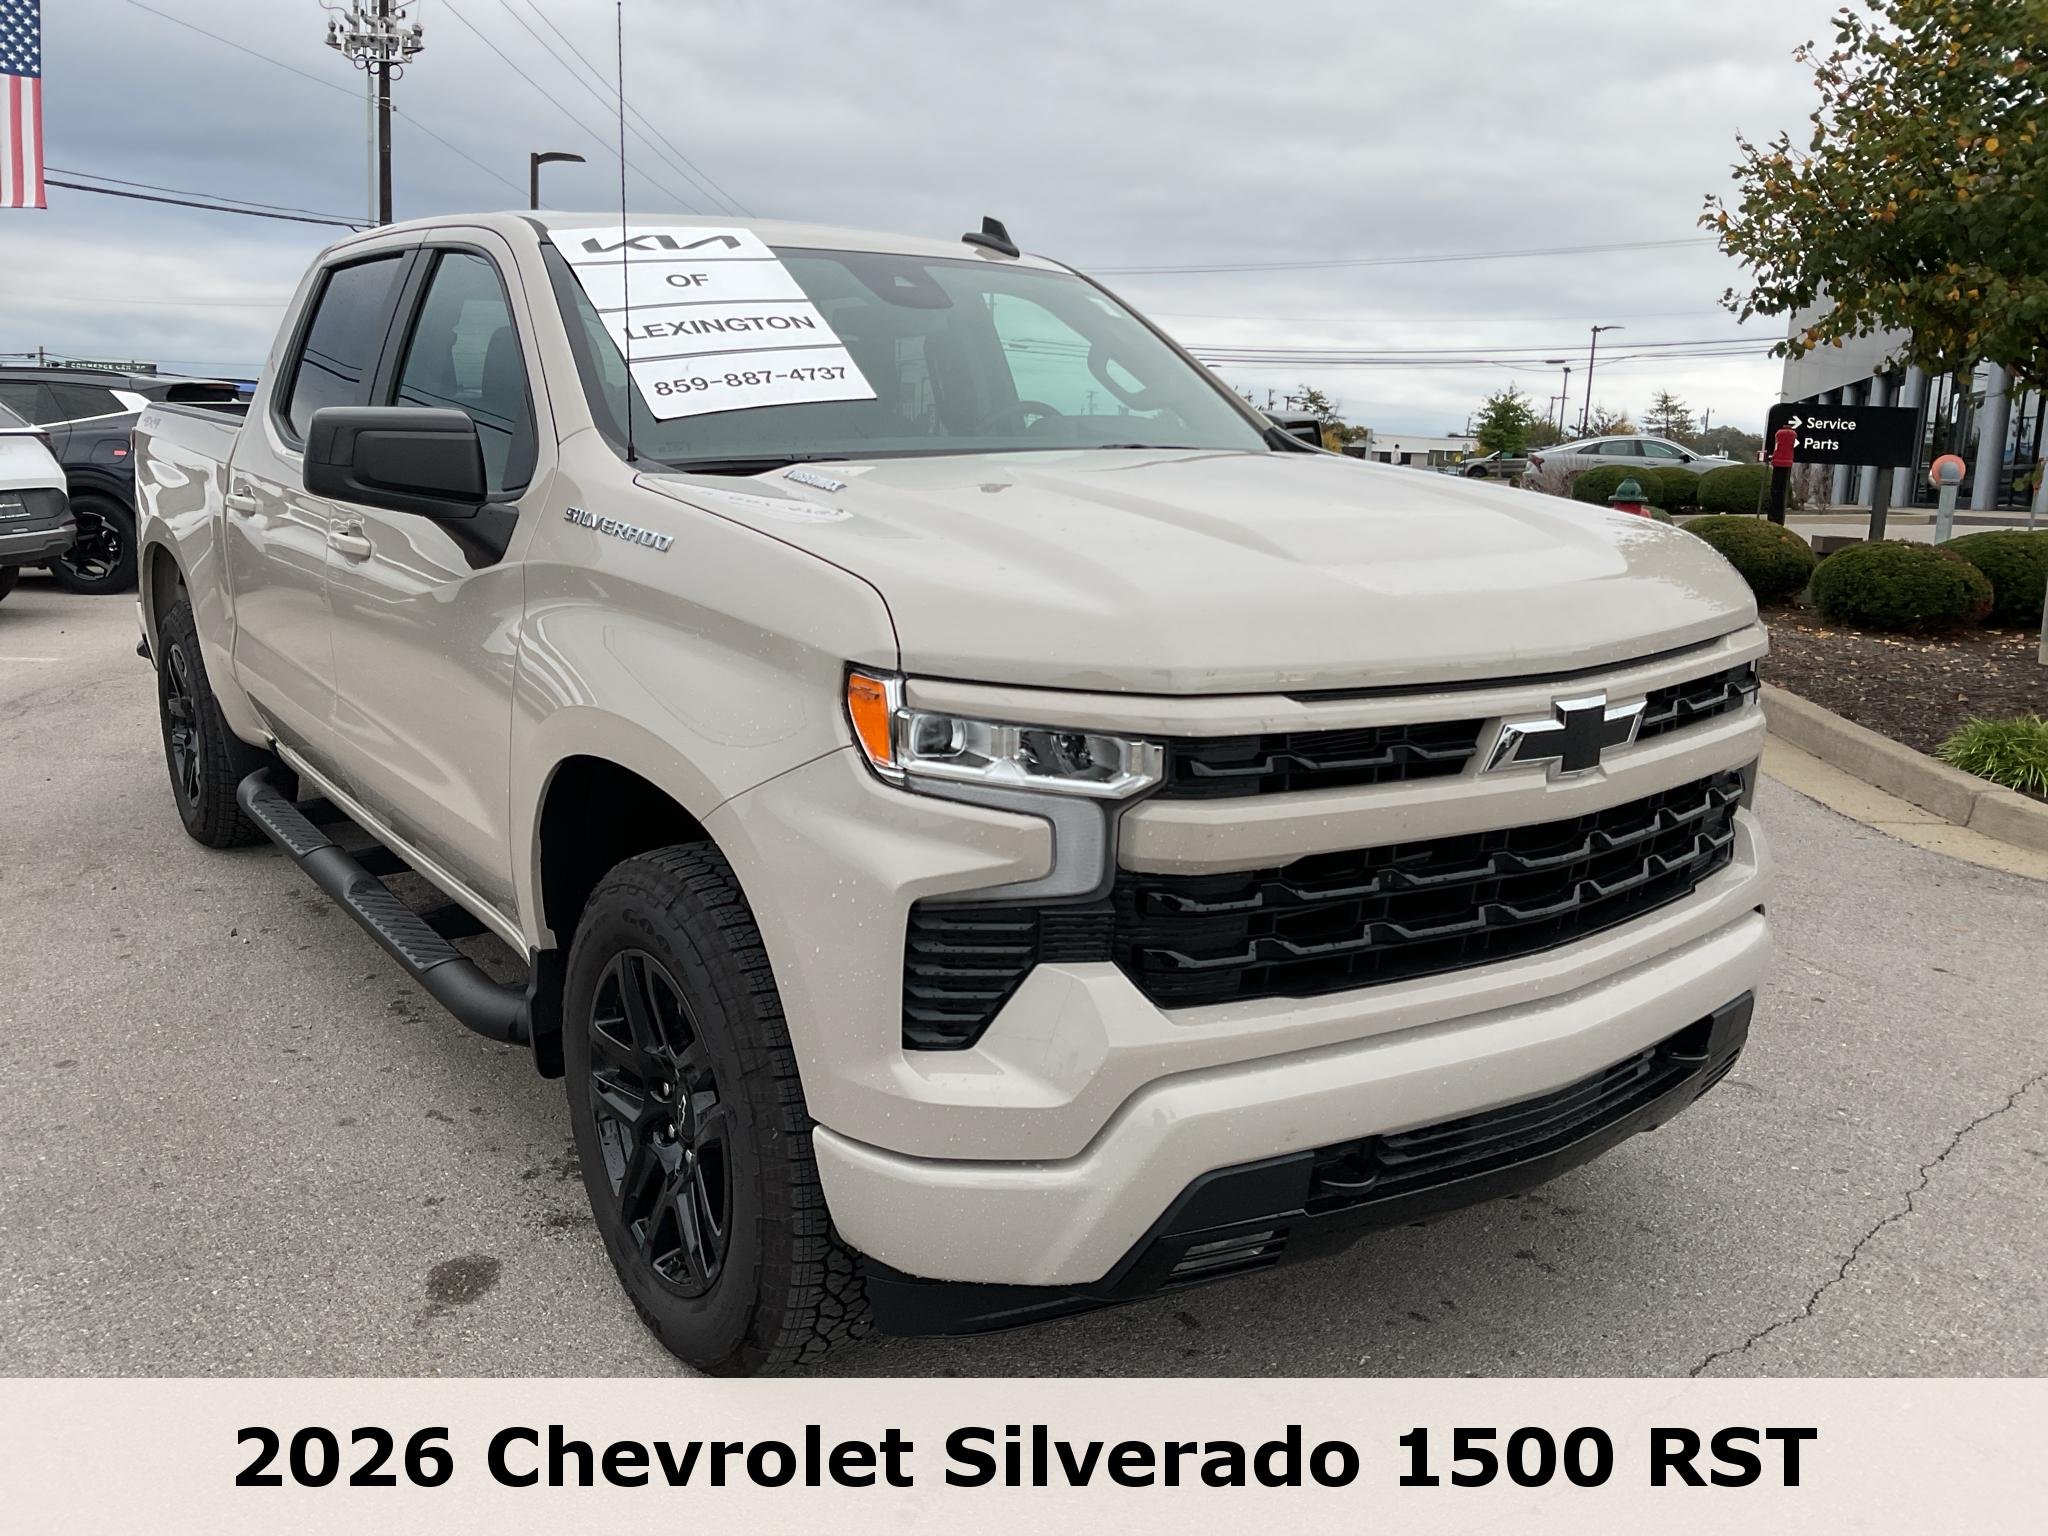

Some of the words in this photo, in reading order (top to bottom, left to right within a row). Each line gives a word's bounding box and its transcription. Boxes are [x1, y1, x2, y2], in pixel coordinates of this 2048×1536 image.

[666, 273, 709, 288] OF
[624, 316, 816, 341] LEXINGTON
[654, 366, 846, 396] 859-887-4737
[1806, 416, 1856, 430] Service
[1803, 437, 1839, 450] Parts
[563, 506, 675, 553] SILVERADO
